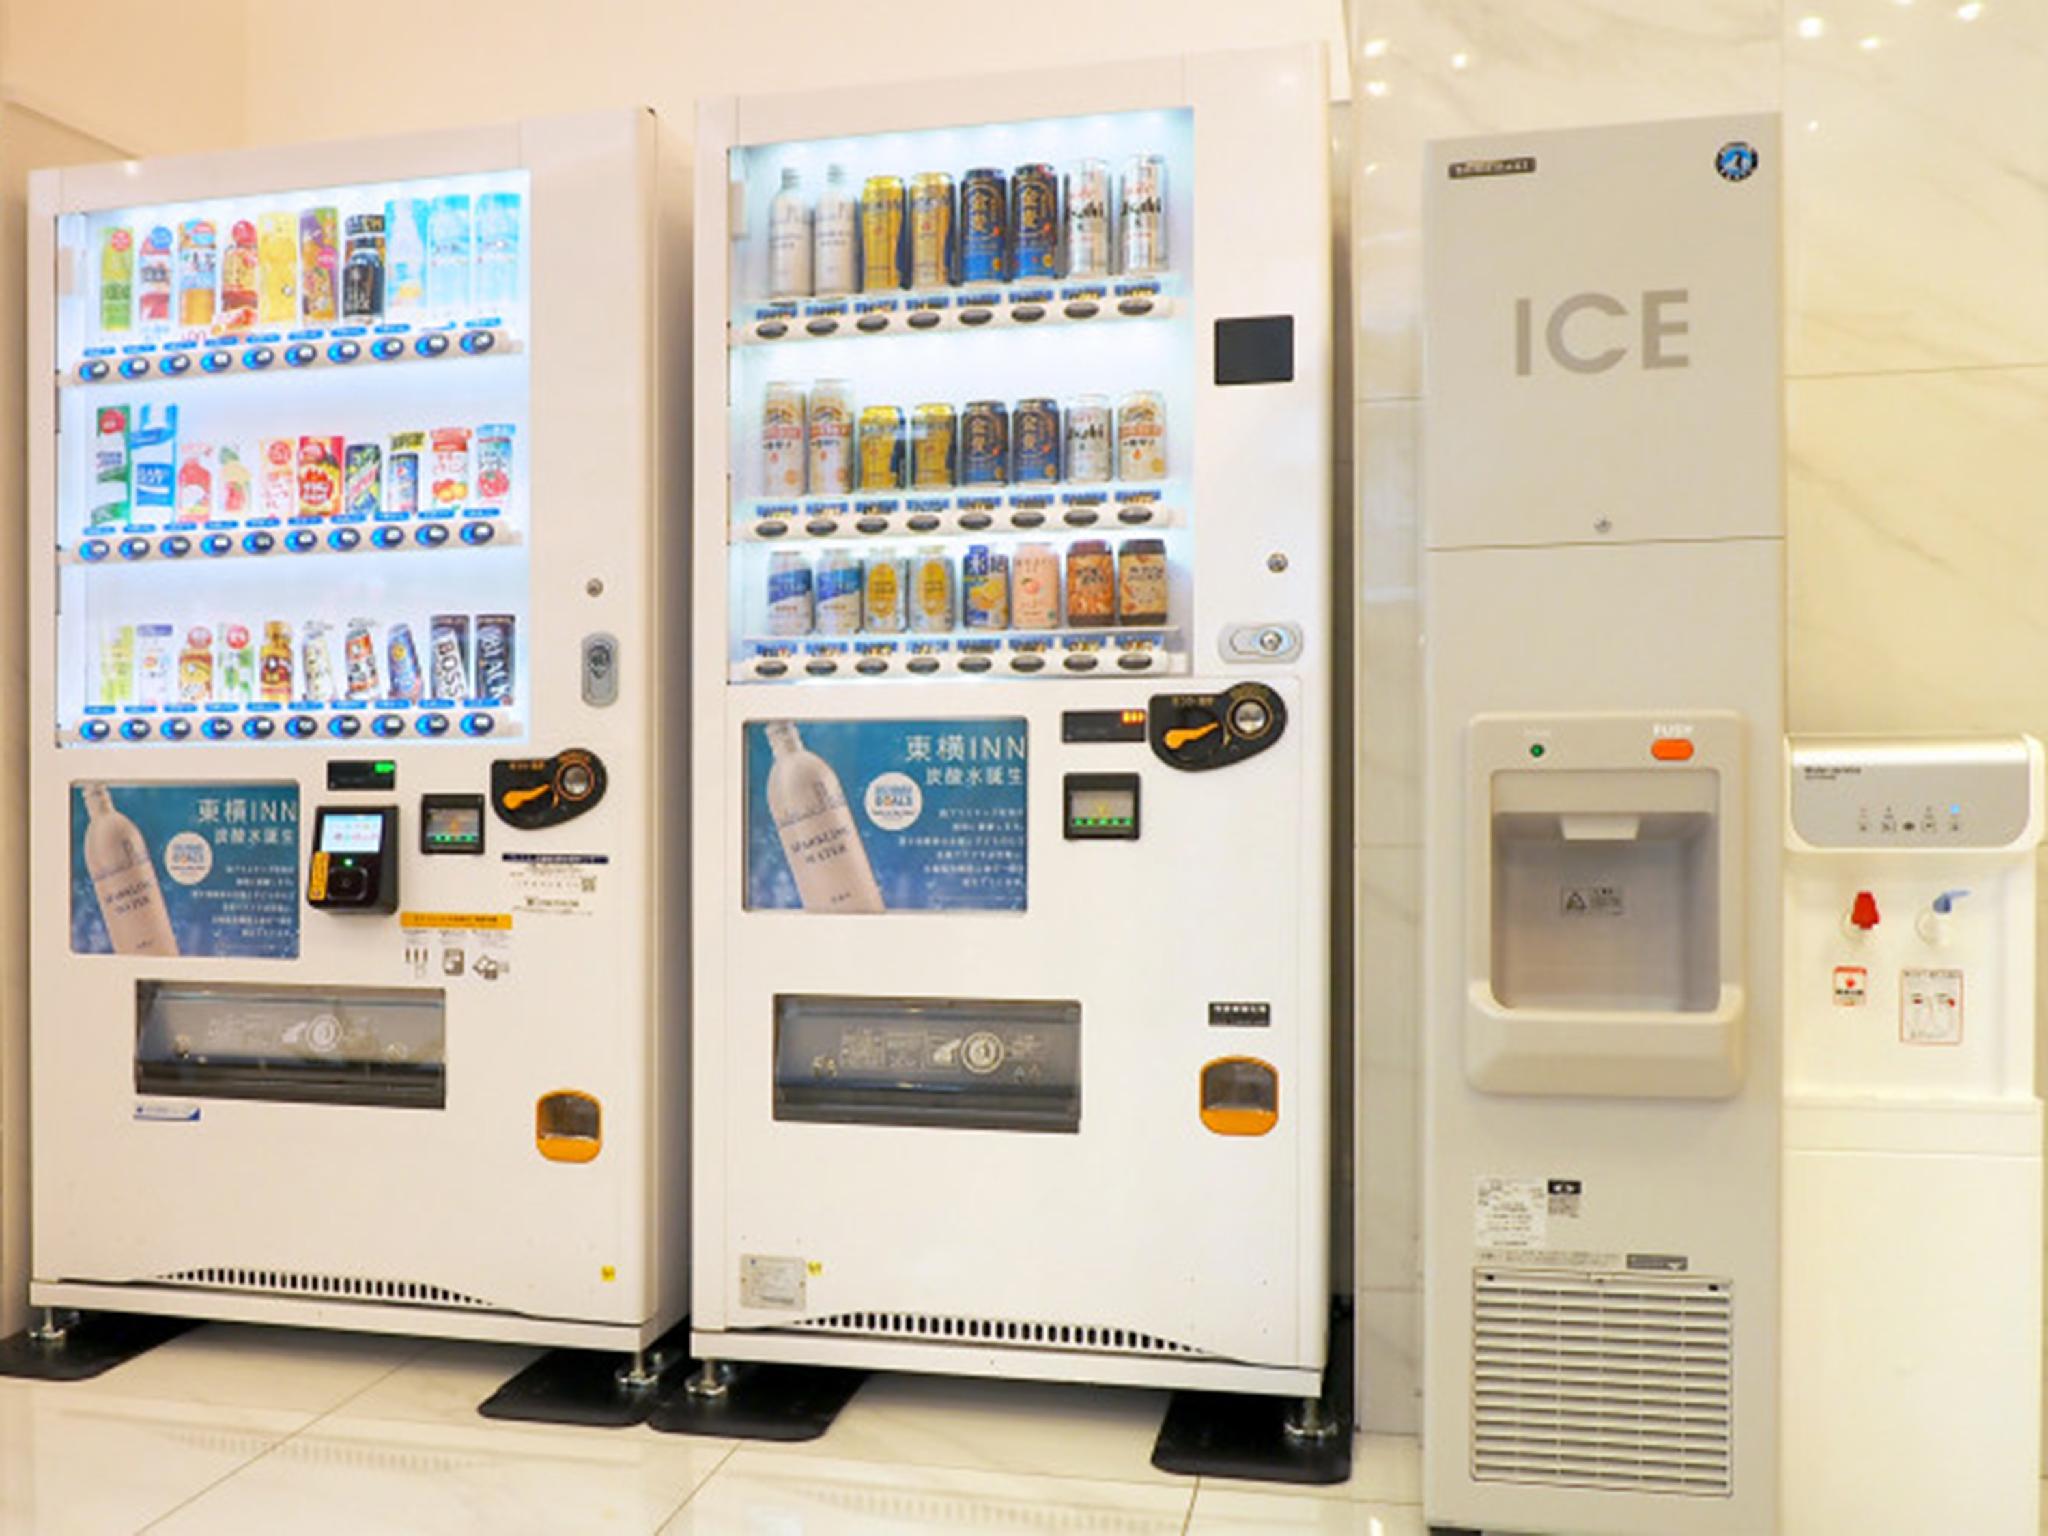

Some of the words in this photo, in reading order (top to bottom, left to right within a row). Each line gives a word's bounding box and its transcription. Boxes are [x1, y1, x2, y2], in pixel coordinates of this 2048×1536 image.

[1515, 289, 1689, 376] ICE
[437, 640, 466, 697] BOSS
[905, 734, 1026, 762] 東横INN
[197, 797, 299, 824] 東横INN
